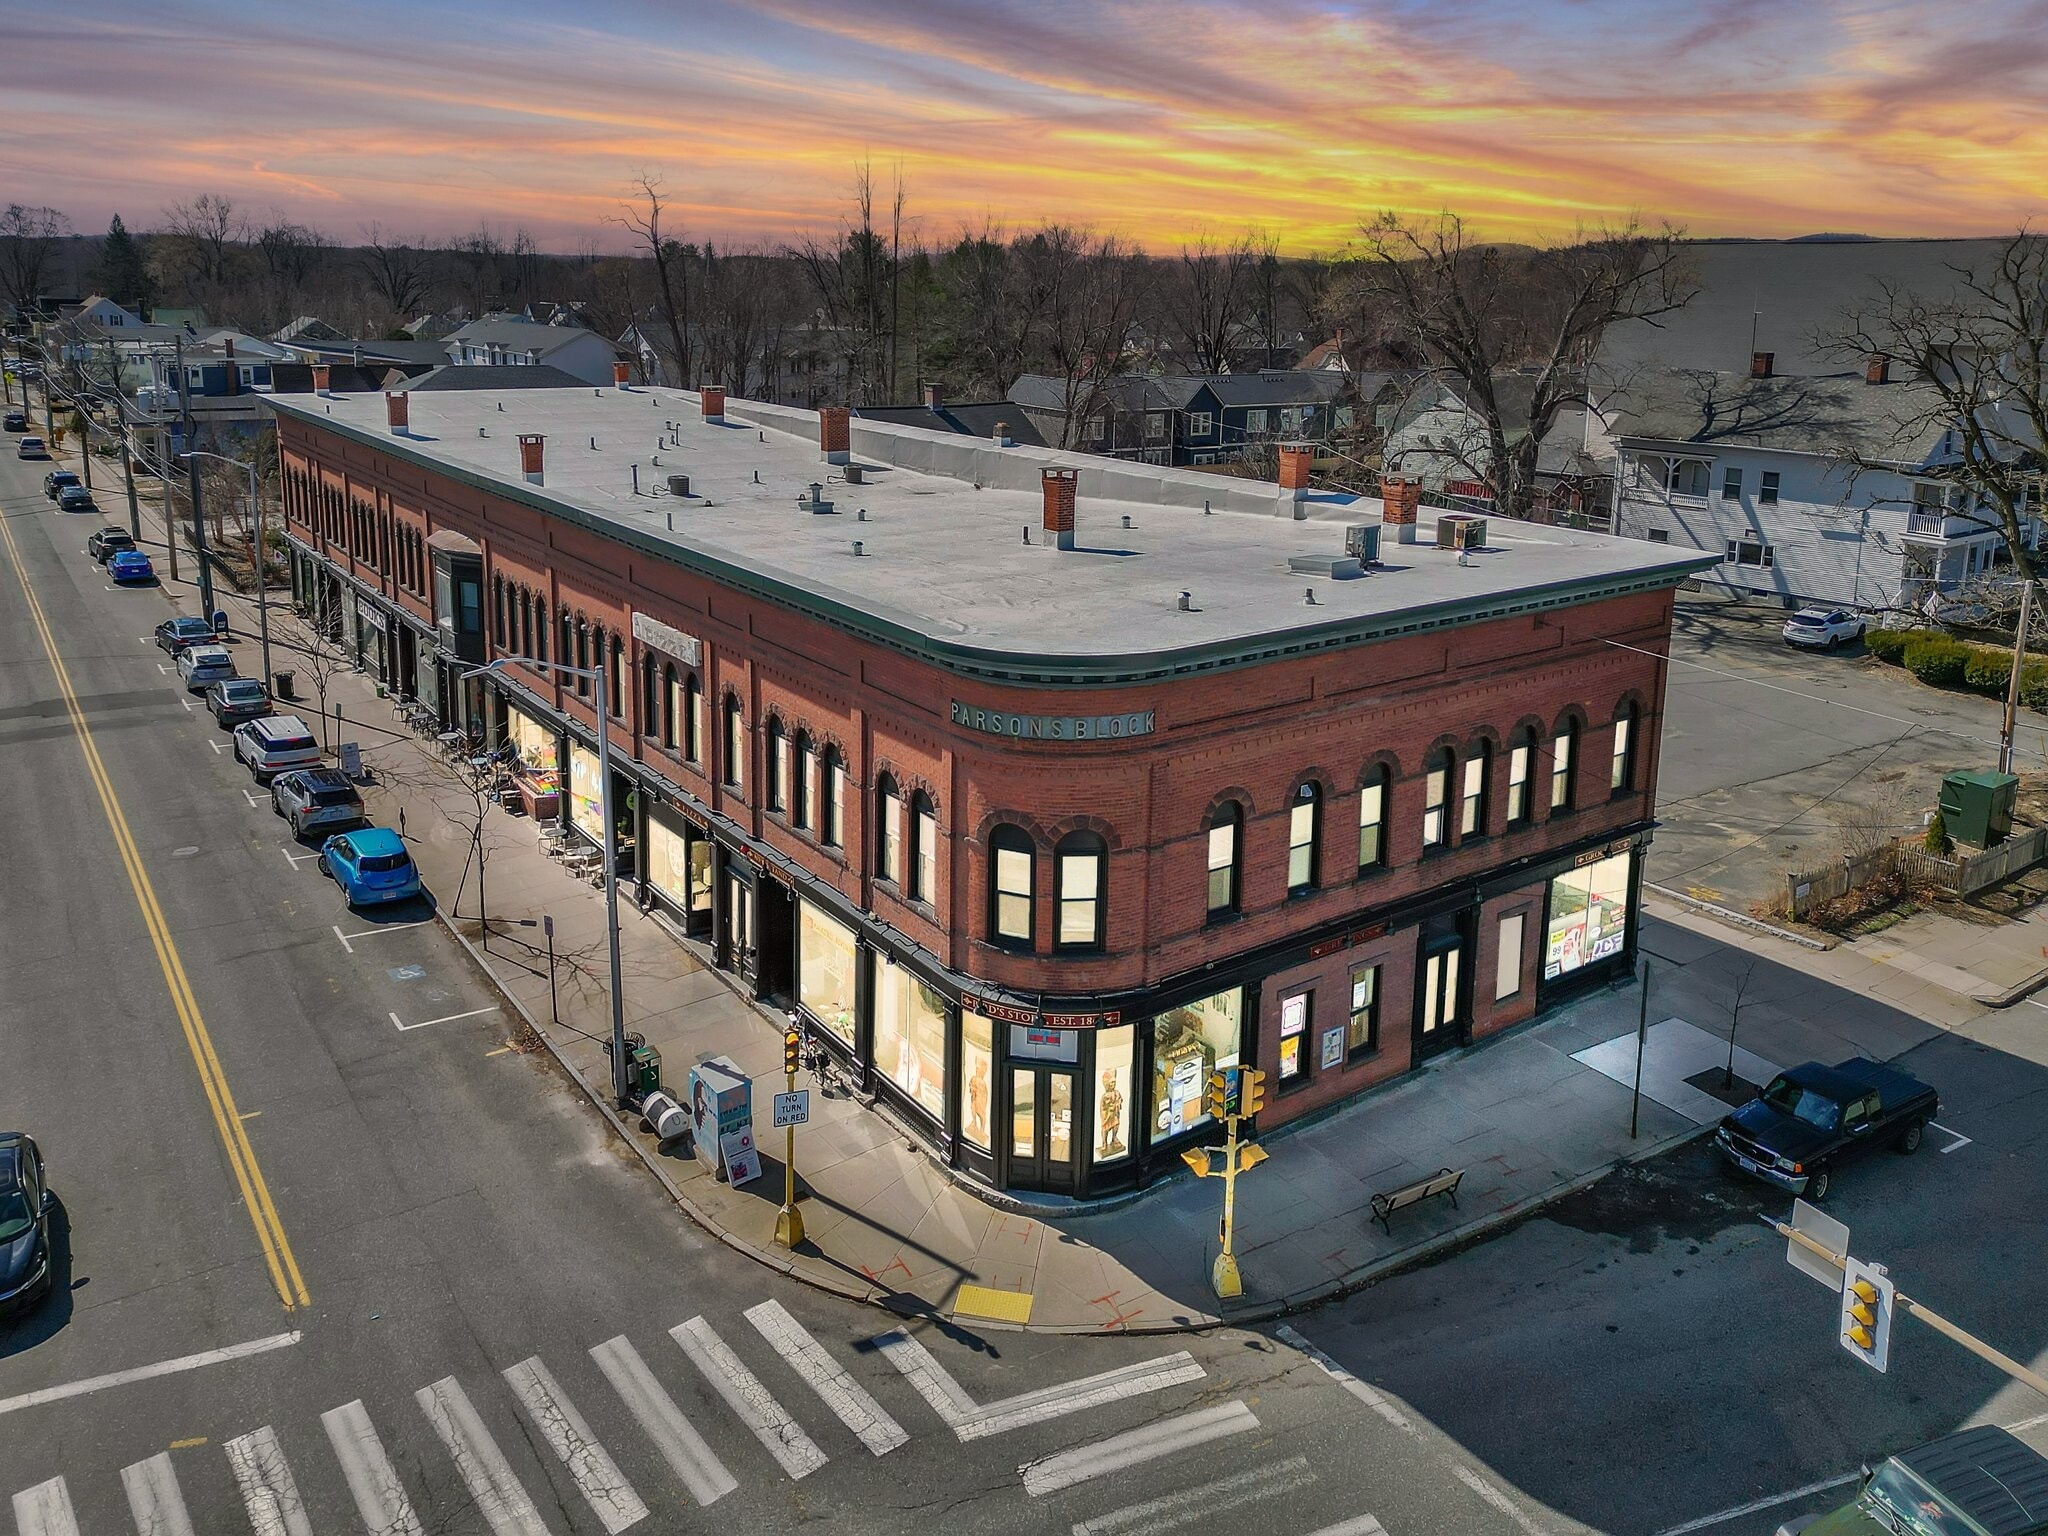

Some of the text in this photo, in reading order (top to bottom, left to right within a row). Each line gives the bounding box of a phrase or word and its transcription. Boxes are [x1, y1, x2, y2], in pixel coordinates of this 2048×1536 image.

[359, 600, 384, 628] BOOKS
[951, 702, 1155, 739] PARSONS BLOCK
[1053, 1016, 1076, 1025] EST.
[1080, 1015, 1104, 1026] 18
[785, 1095, 798, 1103] NO
[782, 1104, 801, 1113] TURN
[777, 1113, 805, 1124] ON RED
